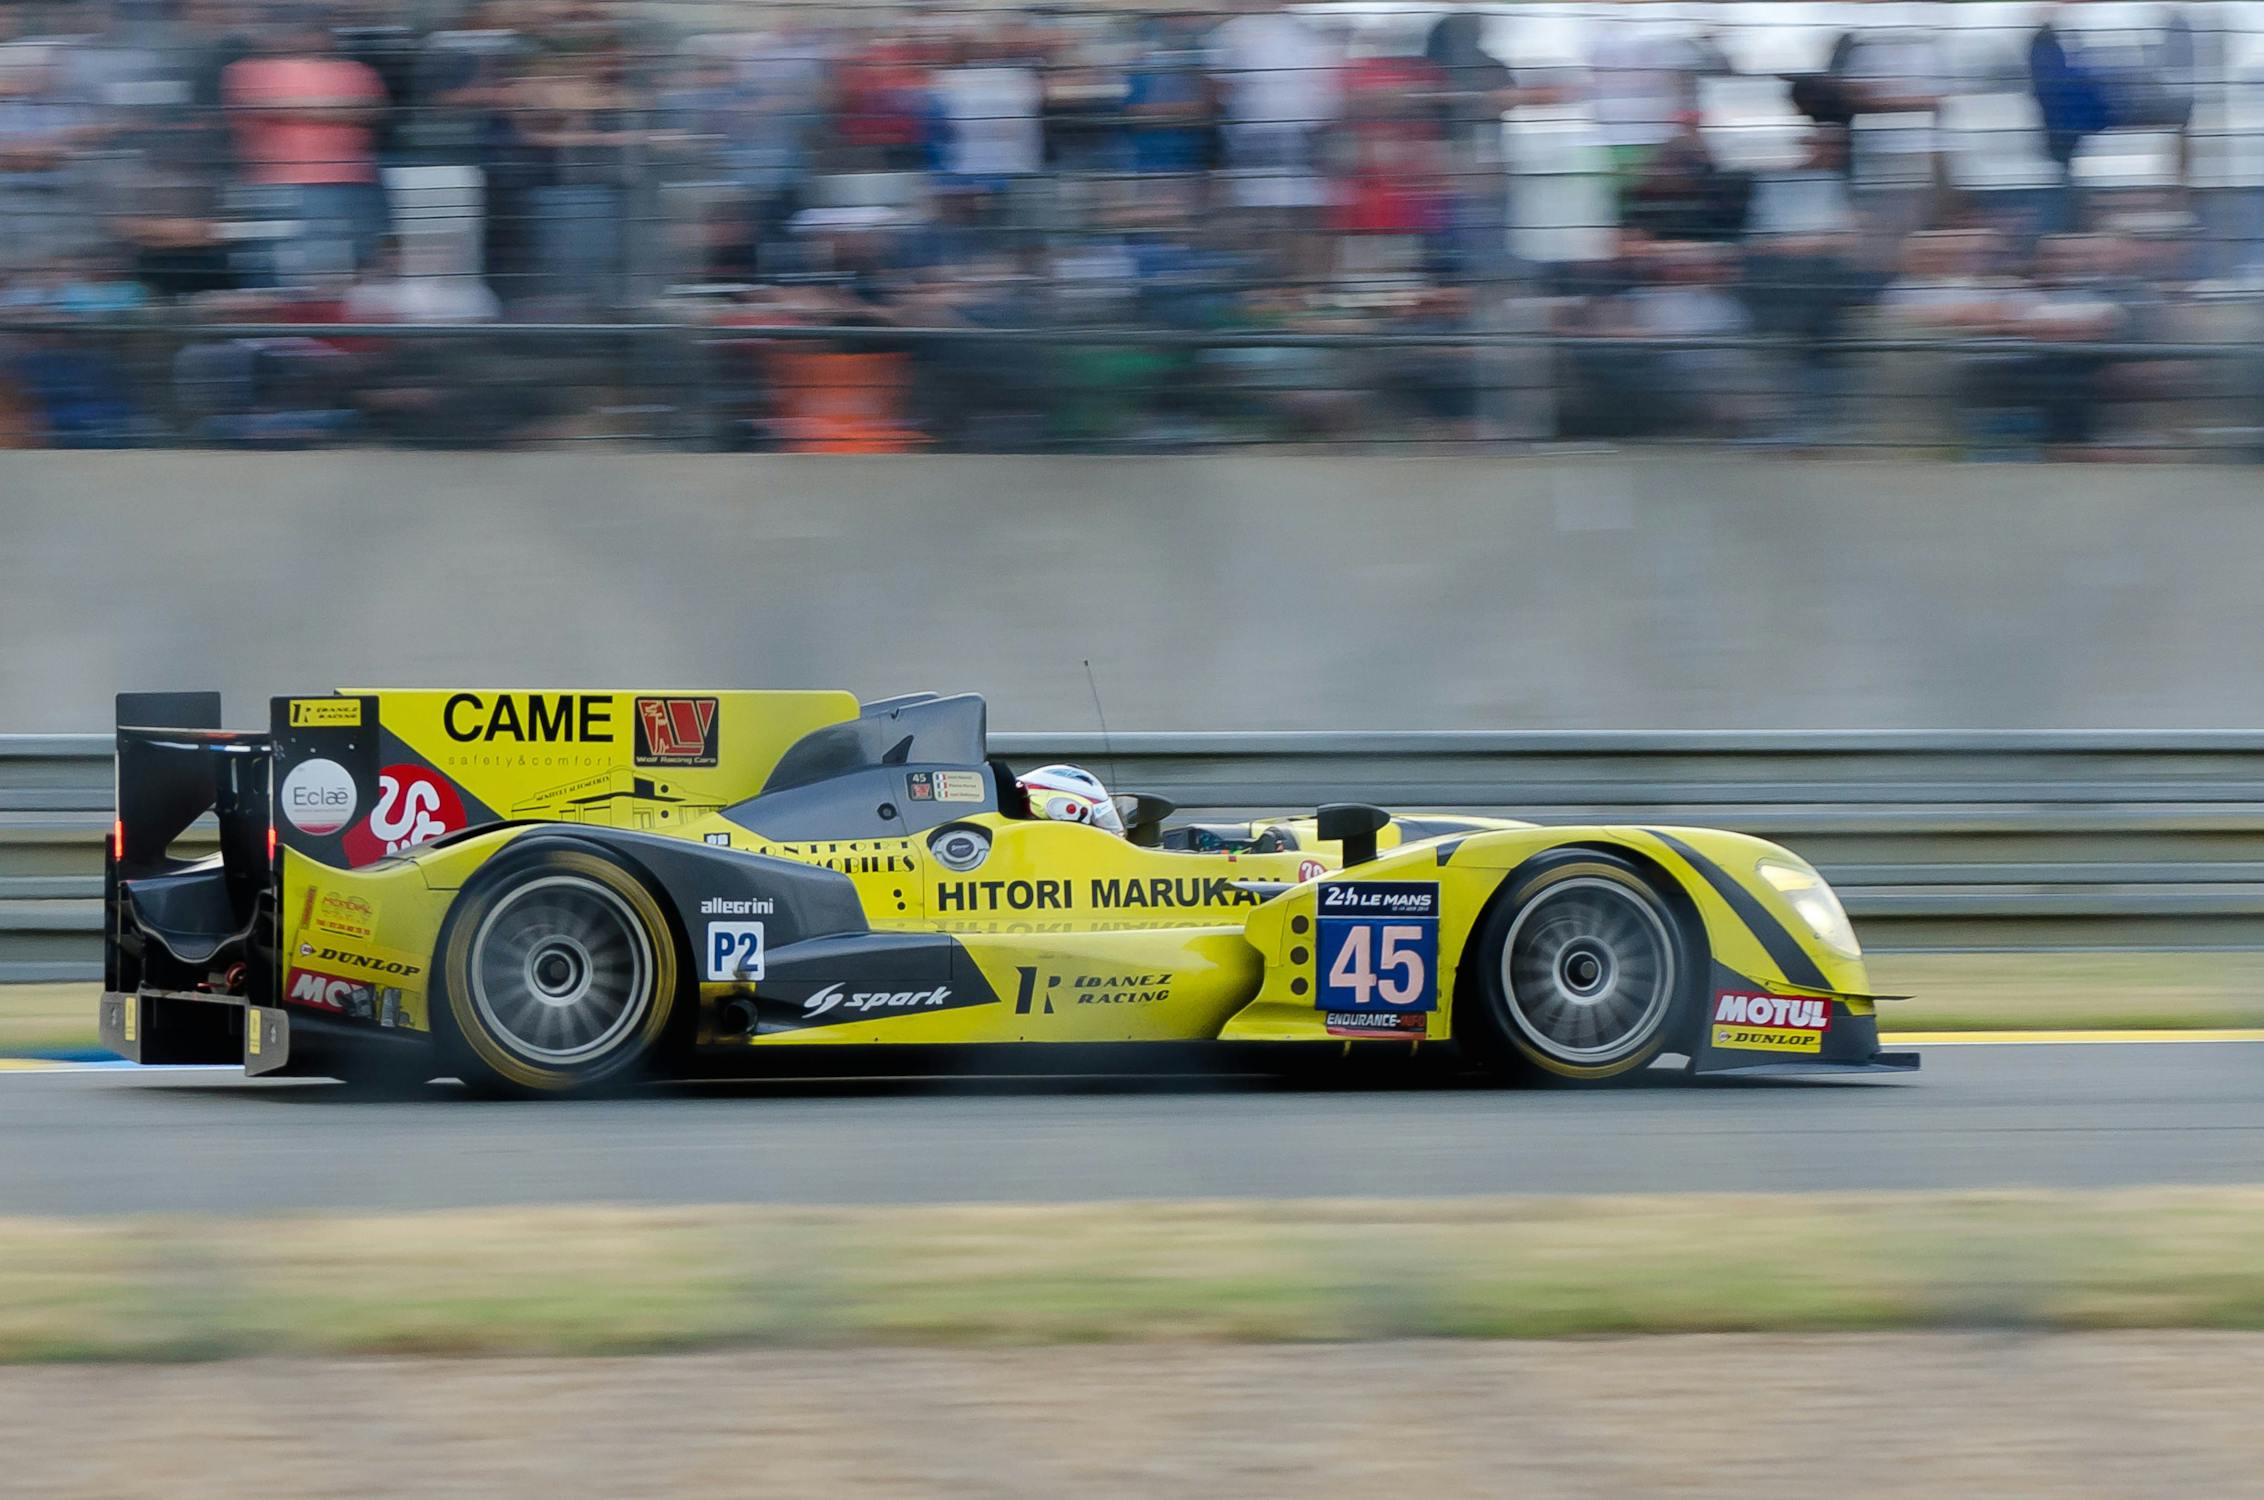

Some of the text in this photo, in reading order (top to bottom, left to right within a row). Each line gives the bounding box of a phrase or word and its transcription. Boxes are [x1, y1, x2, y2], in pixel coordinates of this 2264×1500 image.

[443, 692, 614, 743] CAME
[912, 773, 927, 783] 45
[937, 879, 1073, 912] HITORI
[1360, 894, 1383, 906] LE
[1383, 894, 1432, 907] MANS
[318, 948, 421, 977] DUNLOP
[714, 931, 759, 972] P2
[1329, 925, 1425, 1005] 45
[1074, 974, 1173, 988] IBANEZ
[843, 986, 953, 1012] spark
[1077, 990, 1171, 1004] RACING
[1714, 994, 1828, 1028] MOTUL
[1733, 1032, 1816, 1046] DUNLOP
